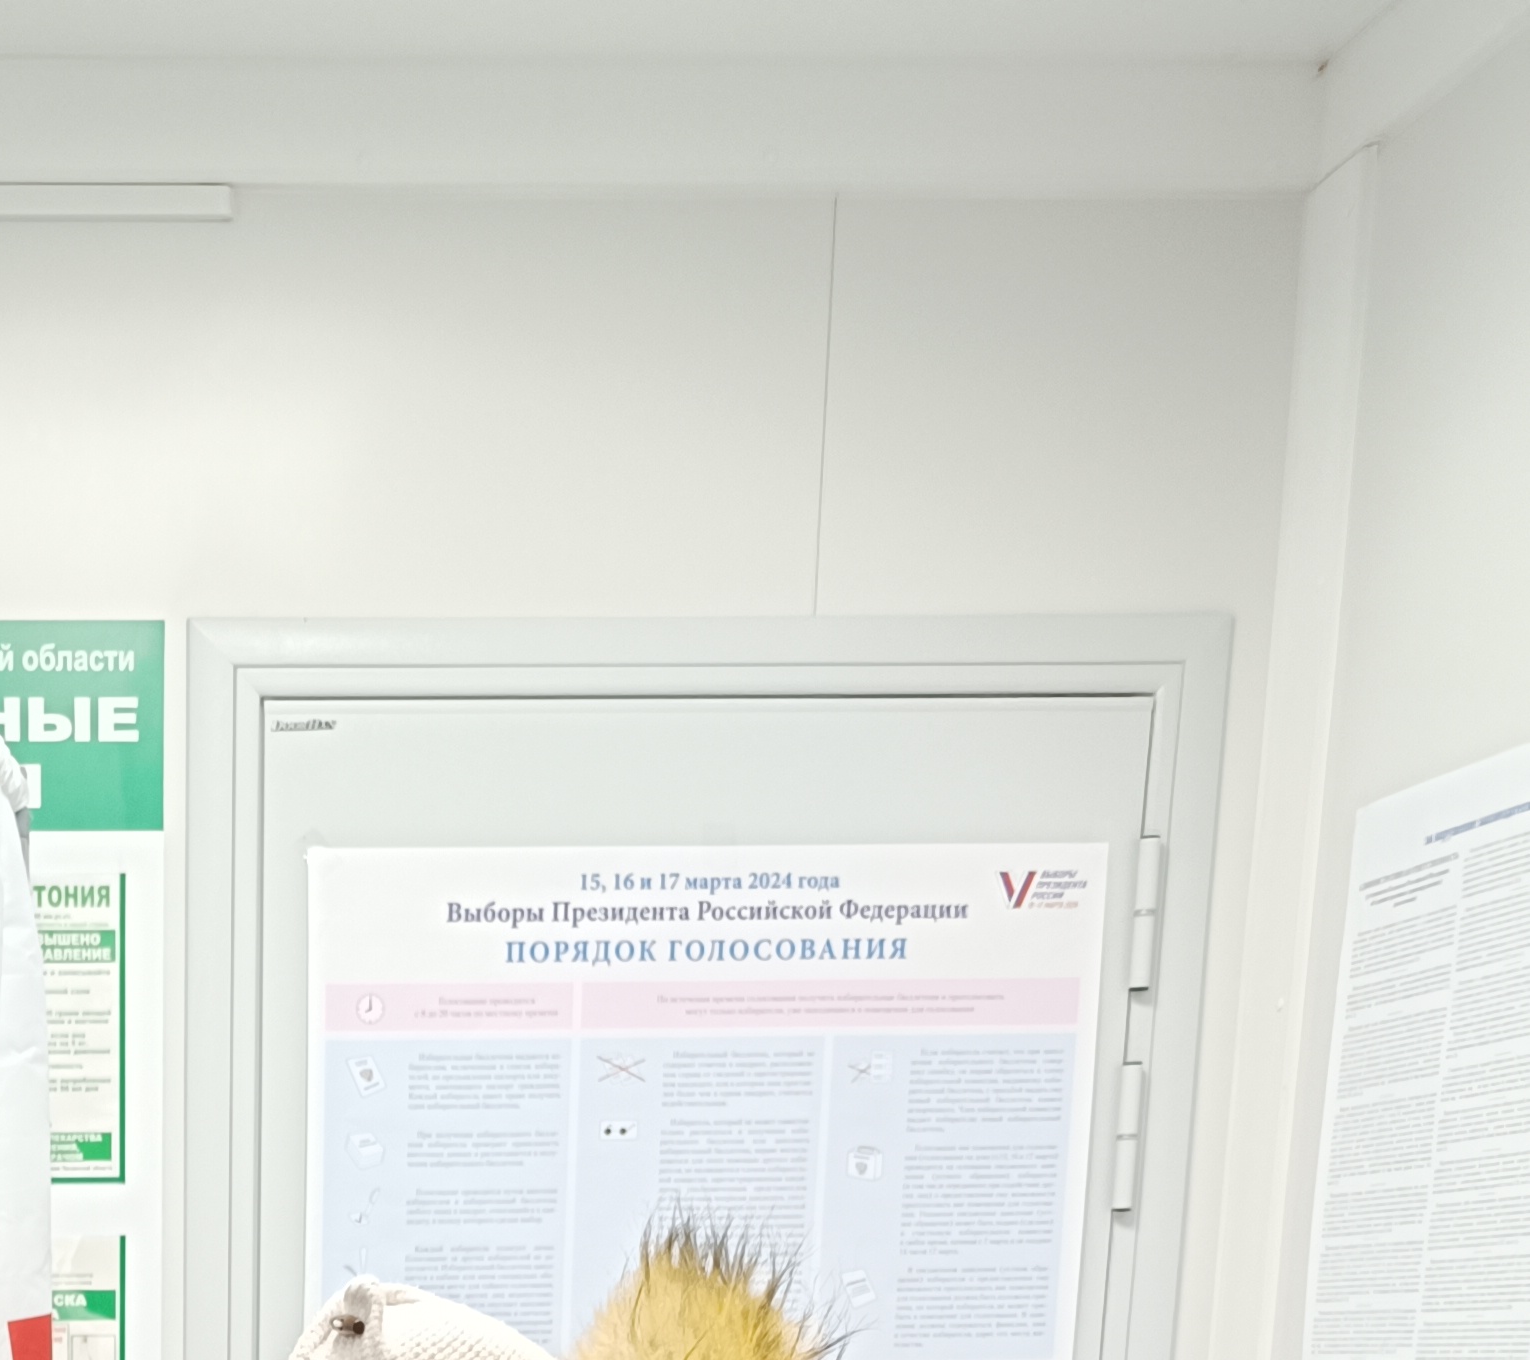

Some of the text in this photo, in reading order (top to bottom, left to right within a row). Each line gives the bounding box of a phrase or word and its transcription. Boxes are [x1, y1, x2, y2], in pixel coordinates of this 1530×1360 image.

[22, 643, 135, 672] области
[580, 872, 840, 895] 15, 16 и 17 марта 2024 года
[33, 885, 111, 908] ТОНИЯ
[446, 899, 970, 929] Выборы Президента Российской Федерации
[43, 947, 112, 961] АВЛЕНИЕ
[505, 938, 908, 967] ПОРЯДОК ГОЛОСОВАНИЯ
[53, 1293, 88, 1307] СКА
